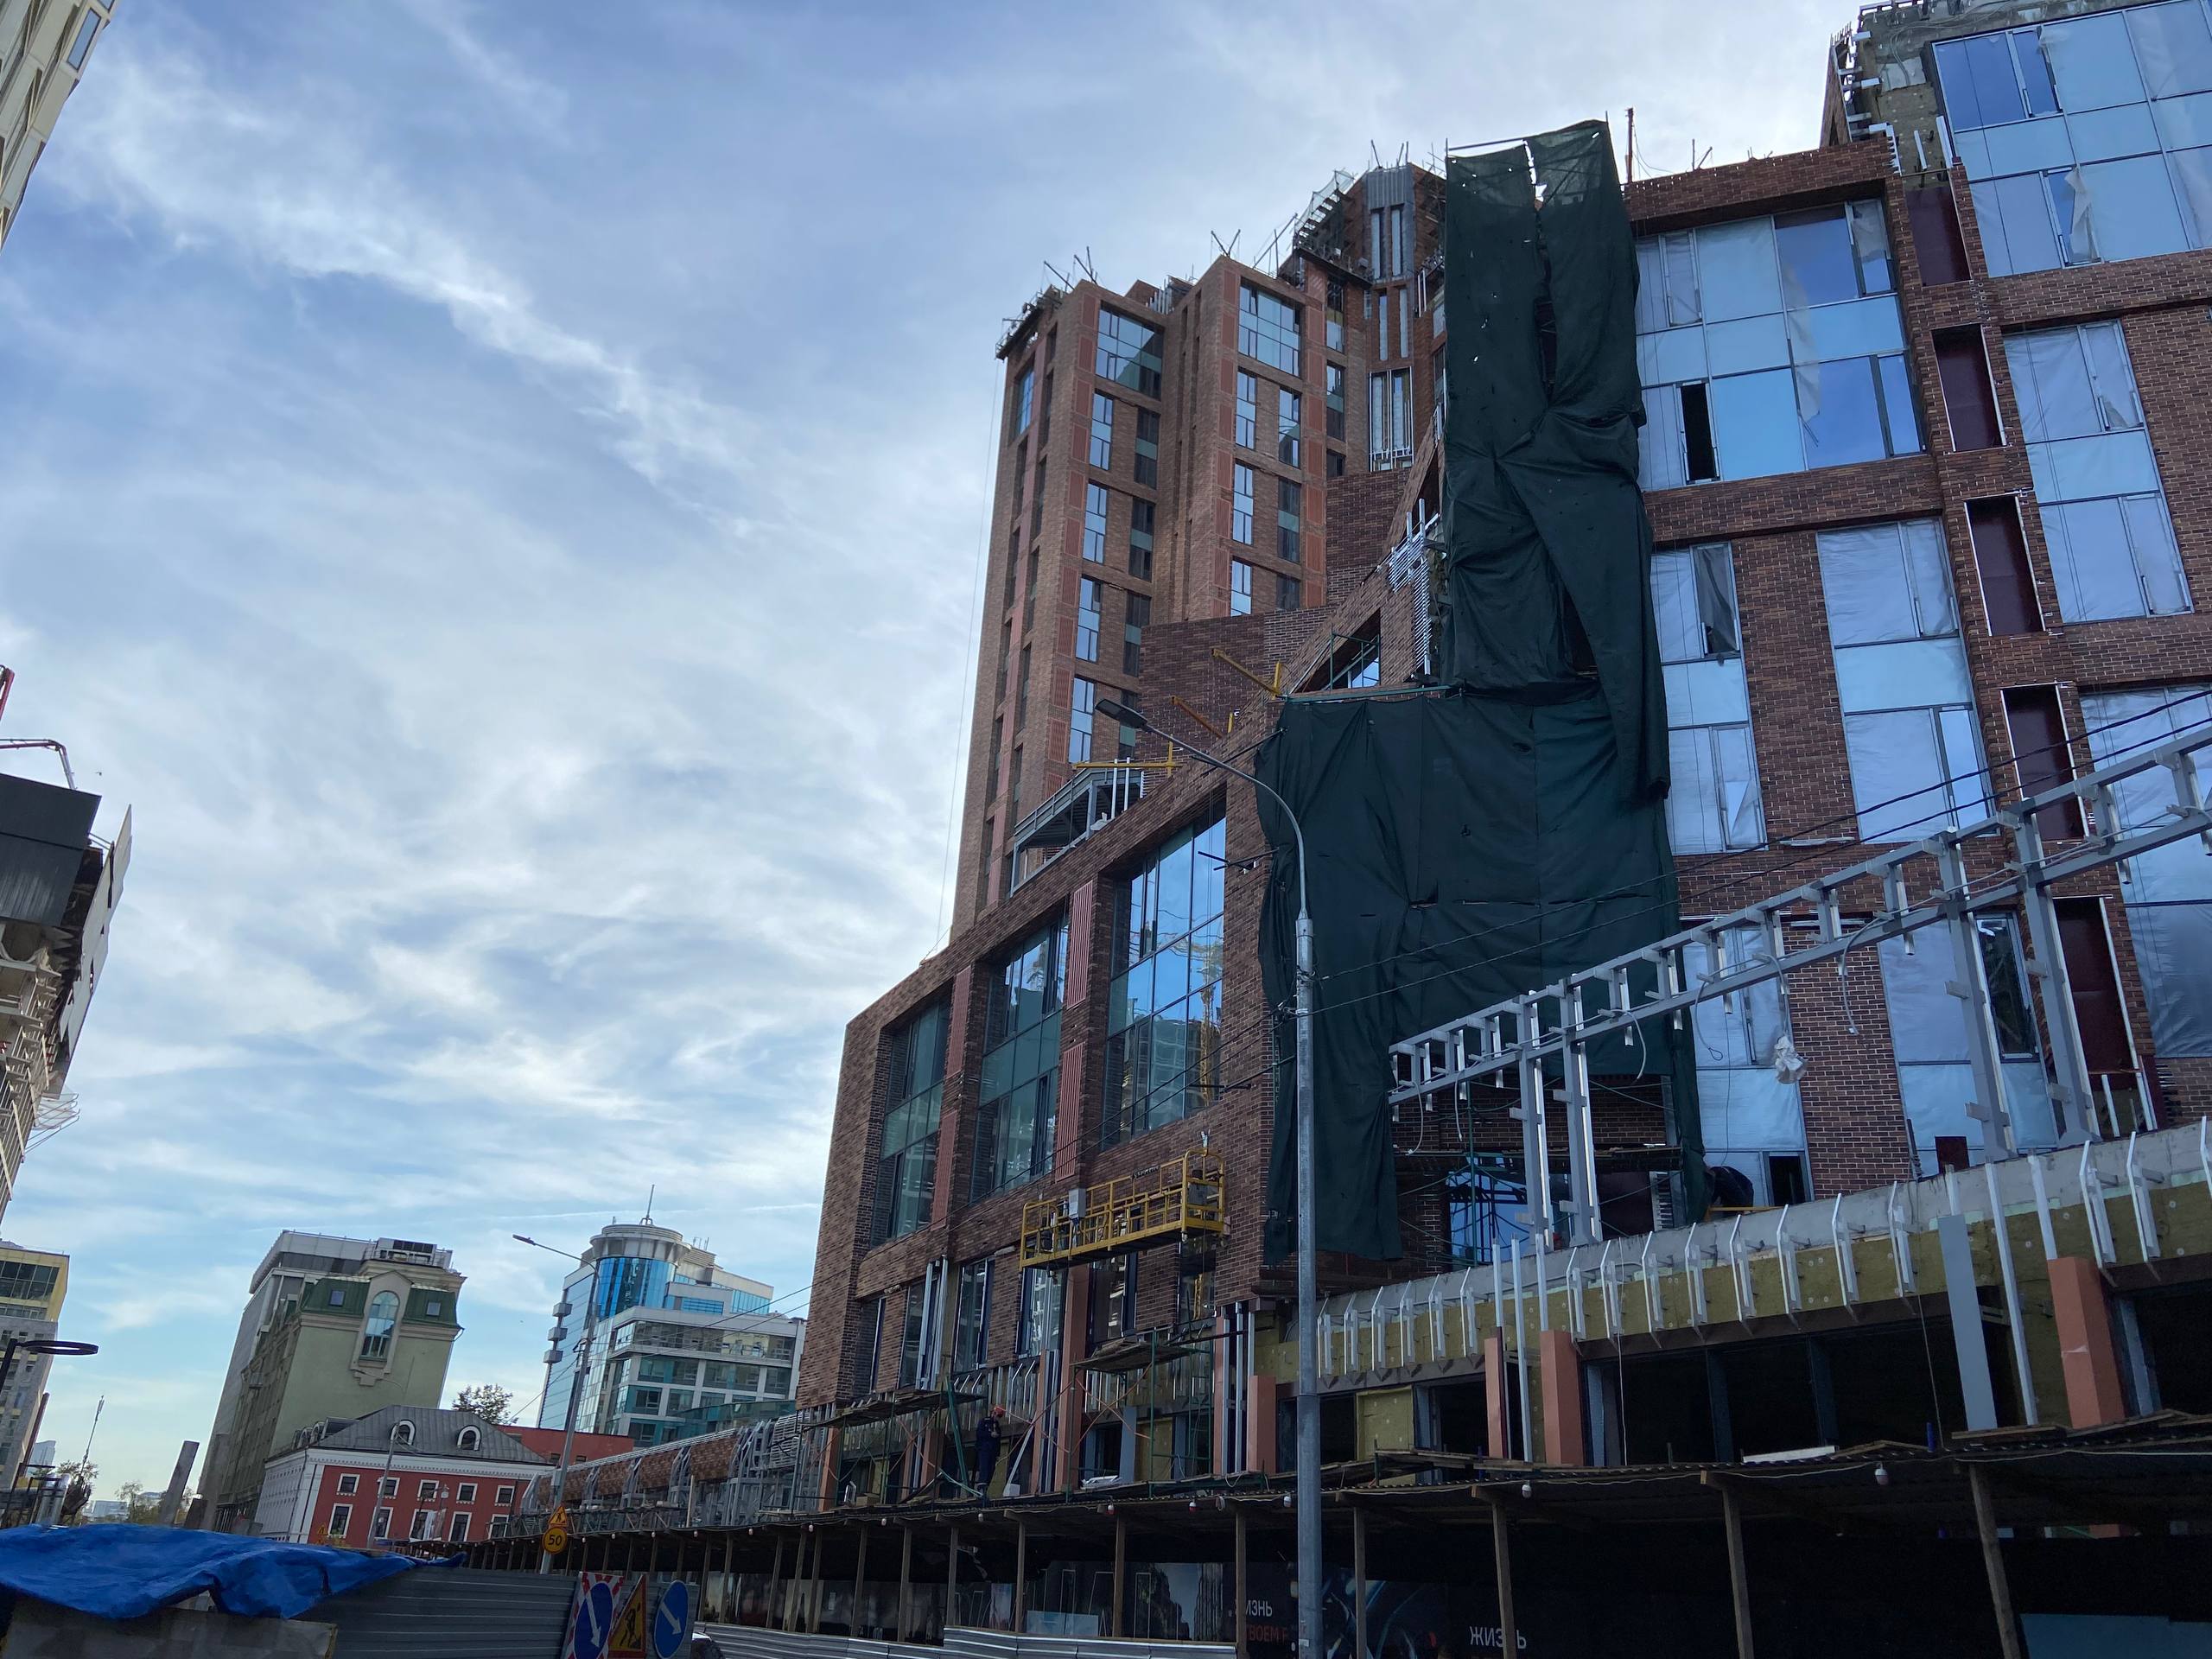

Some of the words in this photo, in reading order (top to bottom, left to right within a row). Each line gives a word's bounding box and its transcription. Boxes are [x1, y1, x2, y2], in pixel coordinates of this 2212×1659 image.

[548, 1534, 563, 1546] 50
[1236, 1599, 1273, 1618] ИЗНЬ
[1469, 1625, 1528, 1649] ЖИЗЬ
